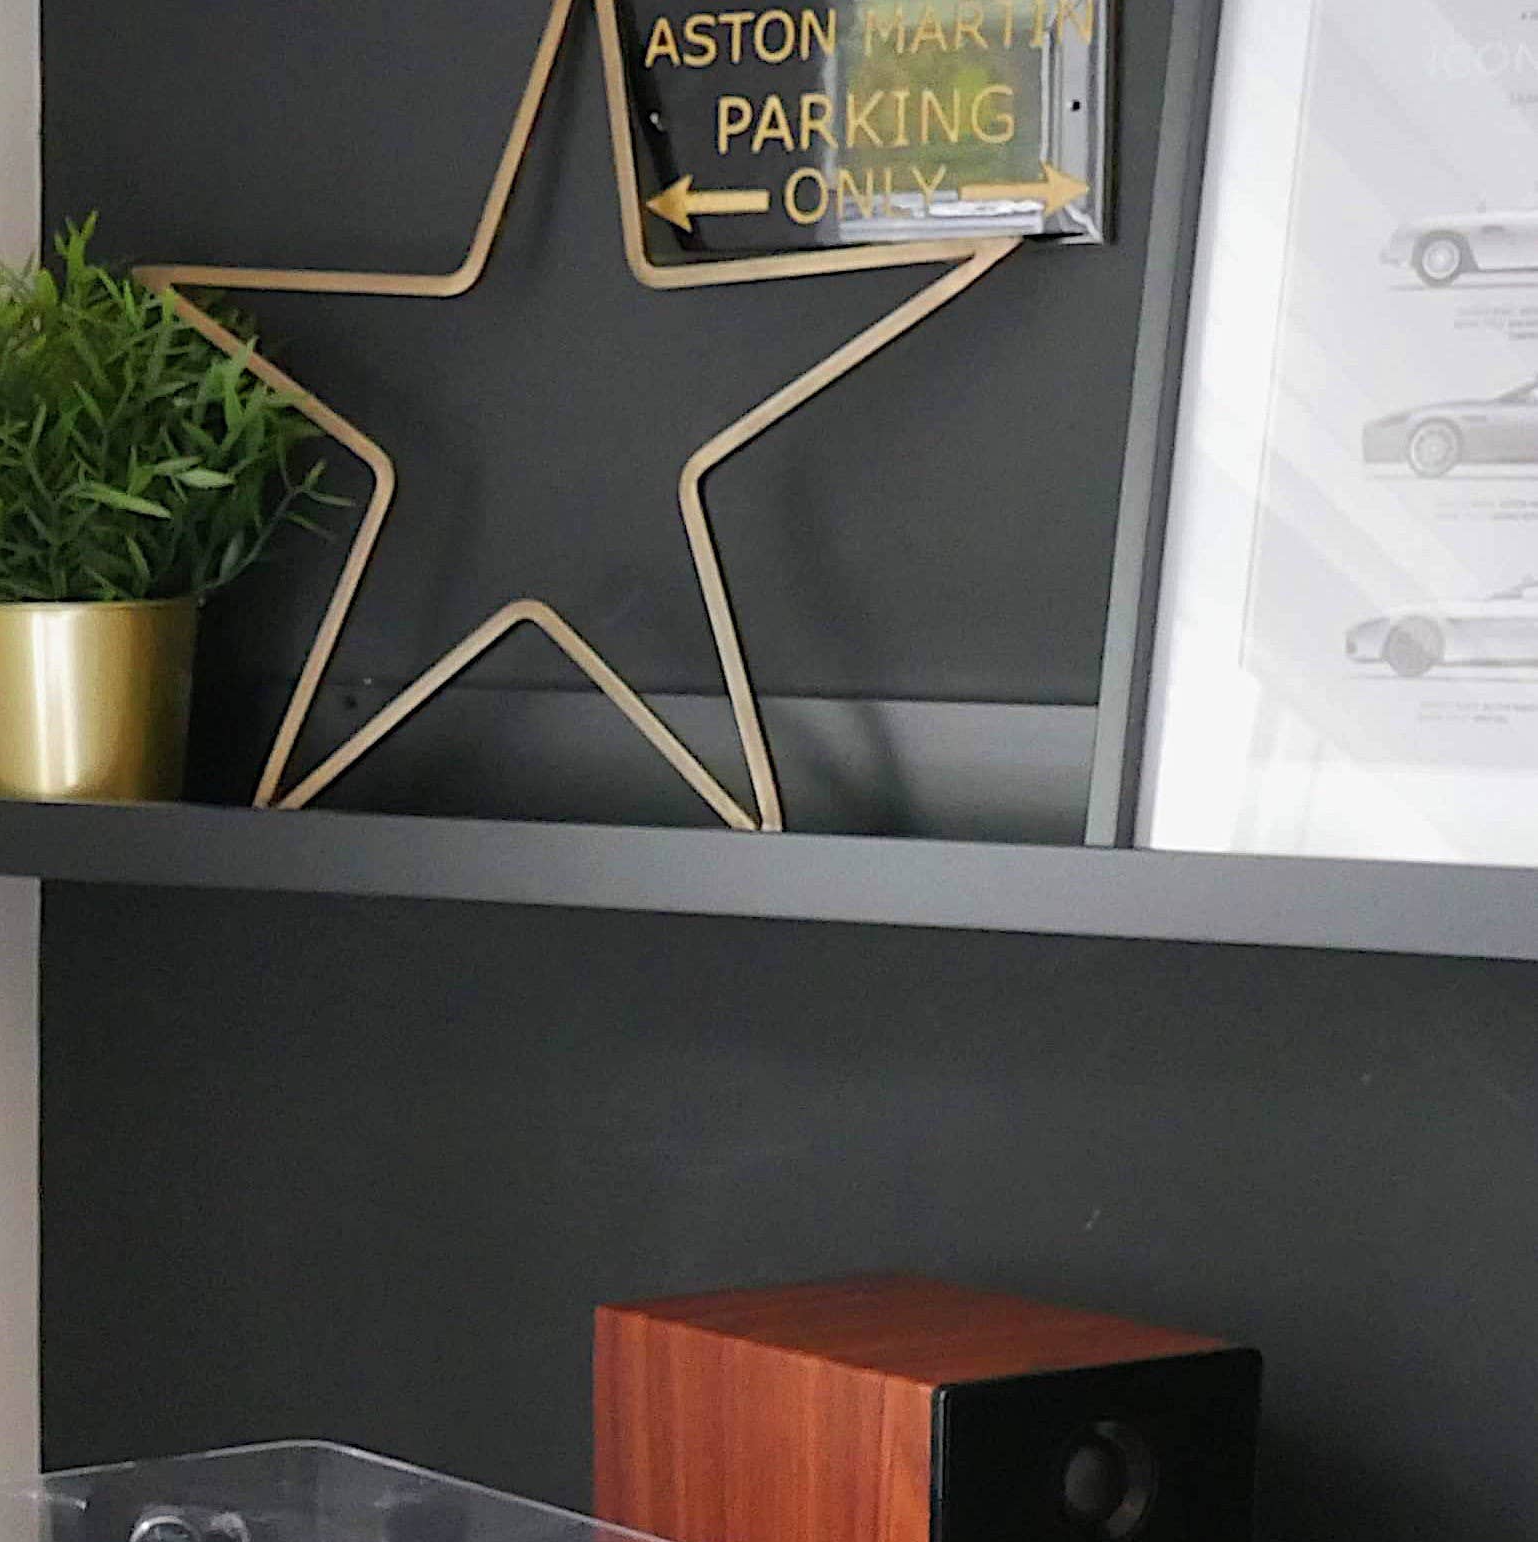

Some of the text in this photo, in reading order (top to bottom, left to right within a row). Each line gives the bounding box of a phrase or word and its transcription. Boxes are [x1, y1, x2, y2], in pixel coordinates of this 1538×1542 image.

[644, 0, 1094, 69] ASTON MARTIN
[716, 86, 1017, 155] PARKING
[784, 163, 946, 226] ONLY
